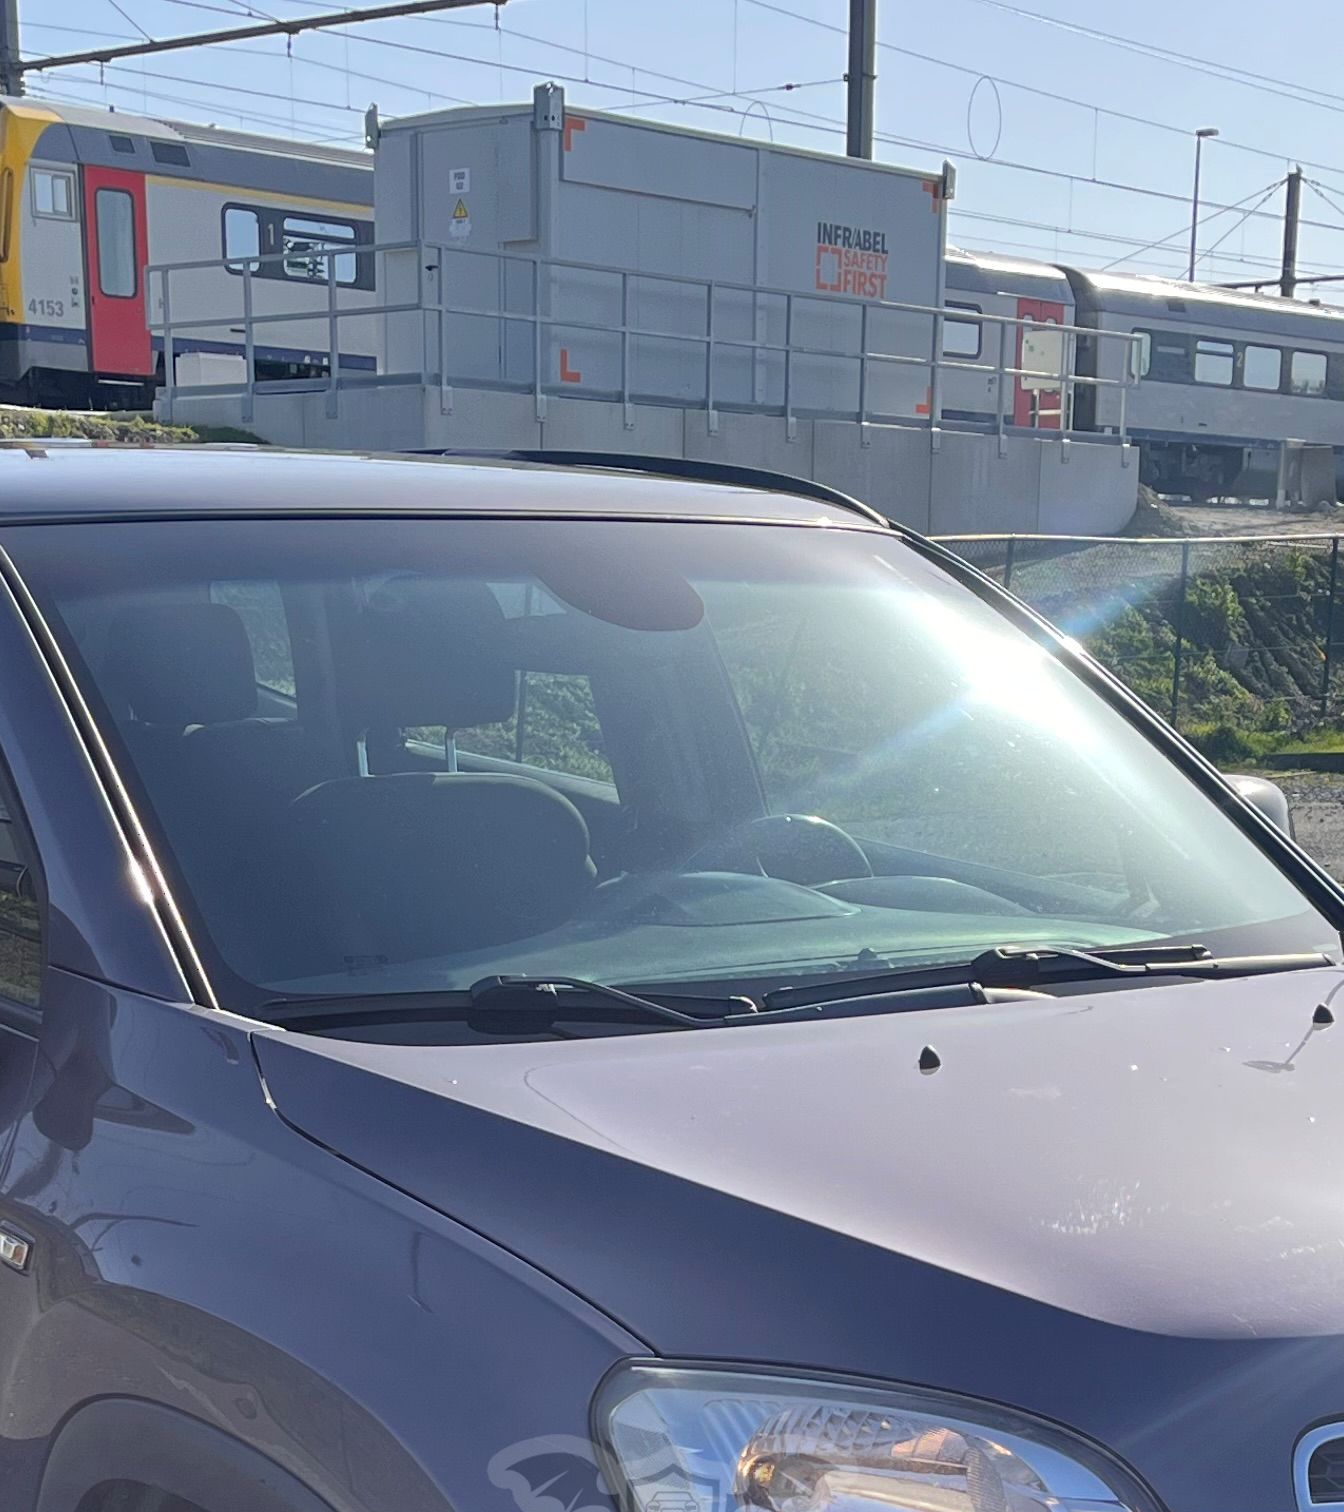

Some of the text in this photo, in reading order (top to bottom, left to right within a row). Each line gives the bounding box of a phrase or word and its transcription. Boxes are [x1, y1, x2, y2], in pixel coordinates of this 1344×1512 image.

[267, 223, 275, 246] 1
[843, 249, 888, 273] SAFETY
[843, 269, 887, 299] FIRST
[28, 299, 64, 318] 4153
